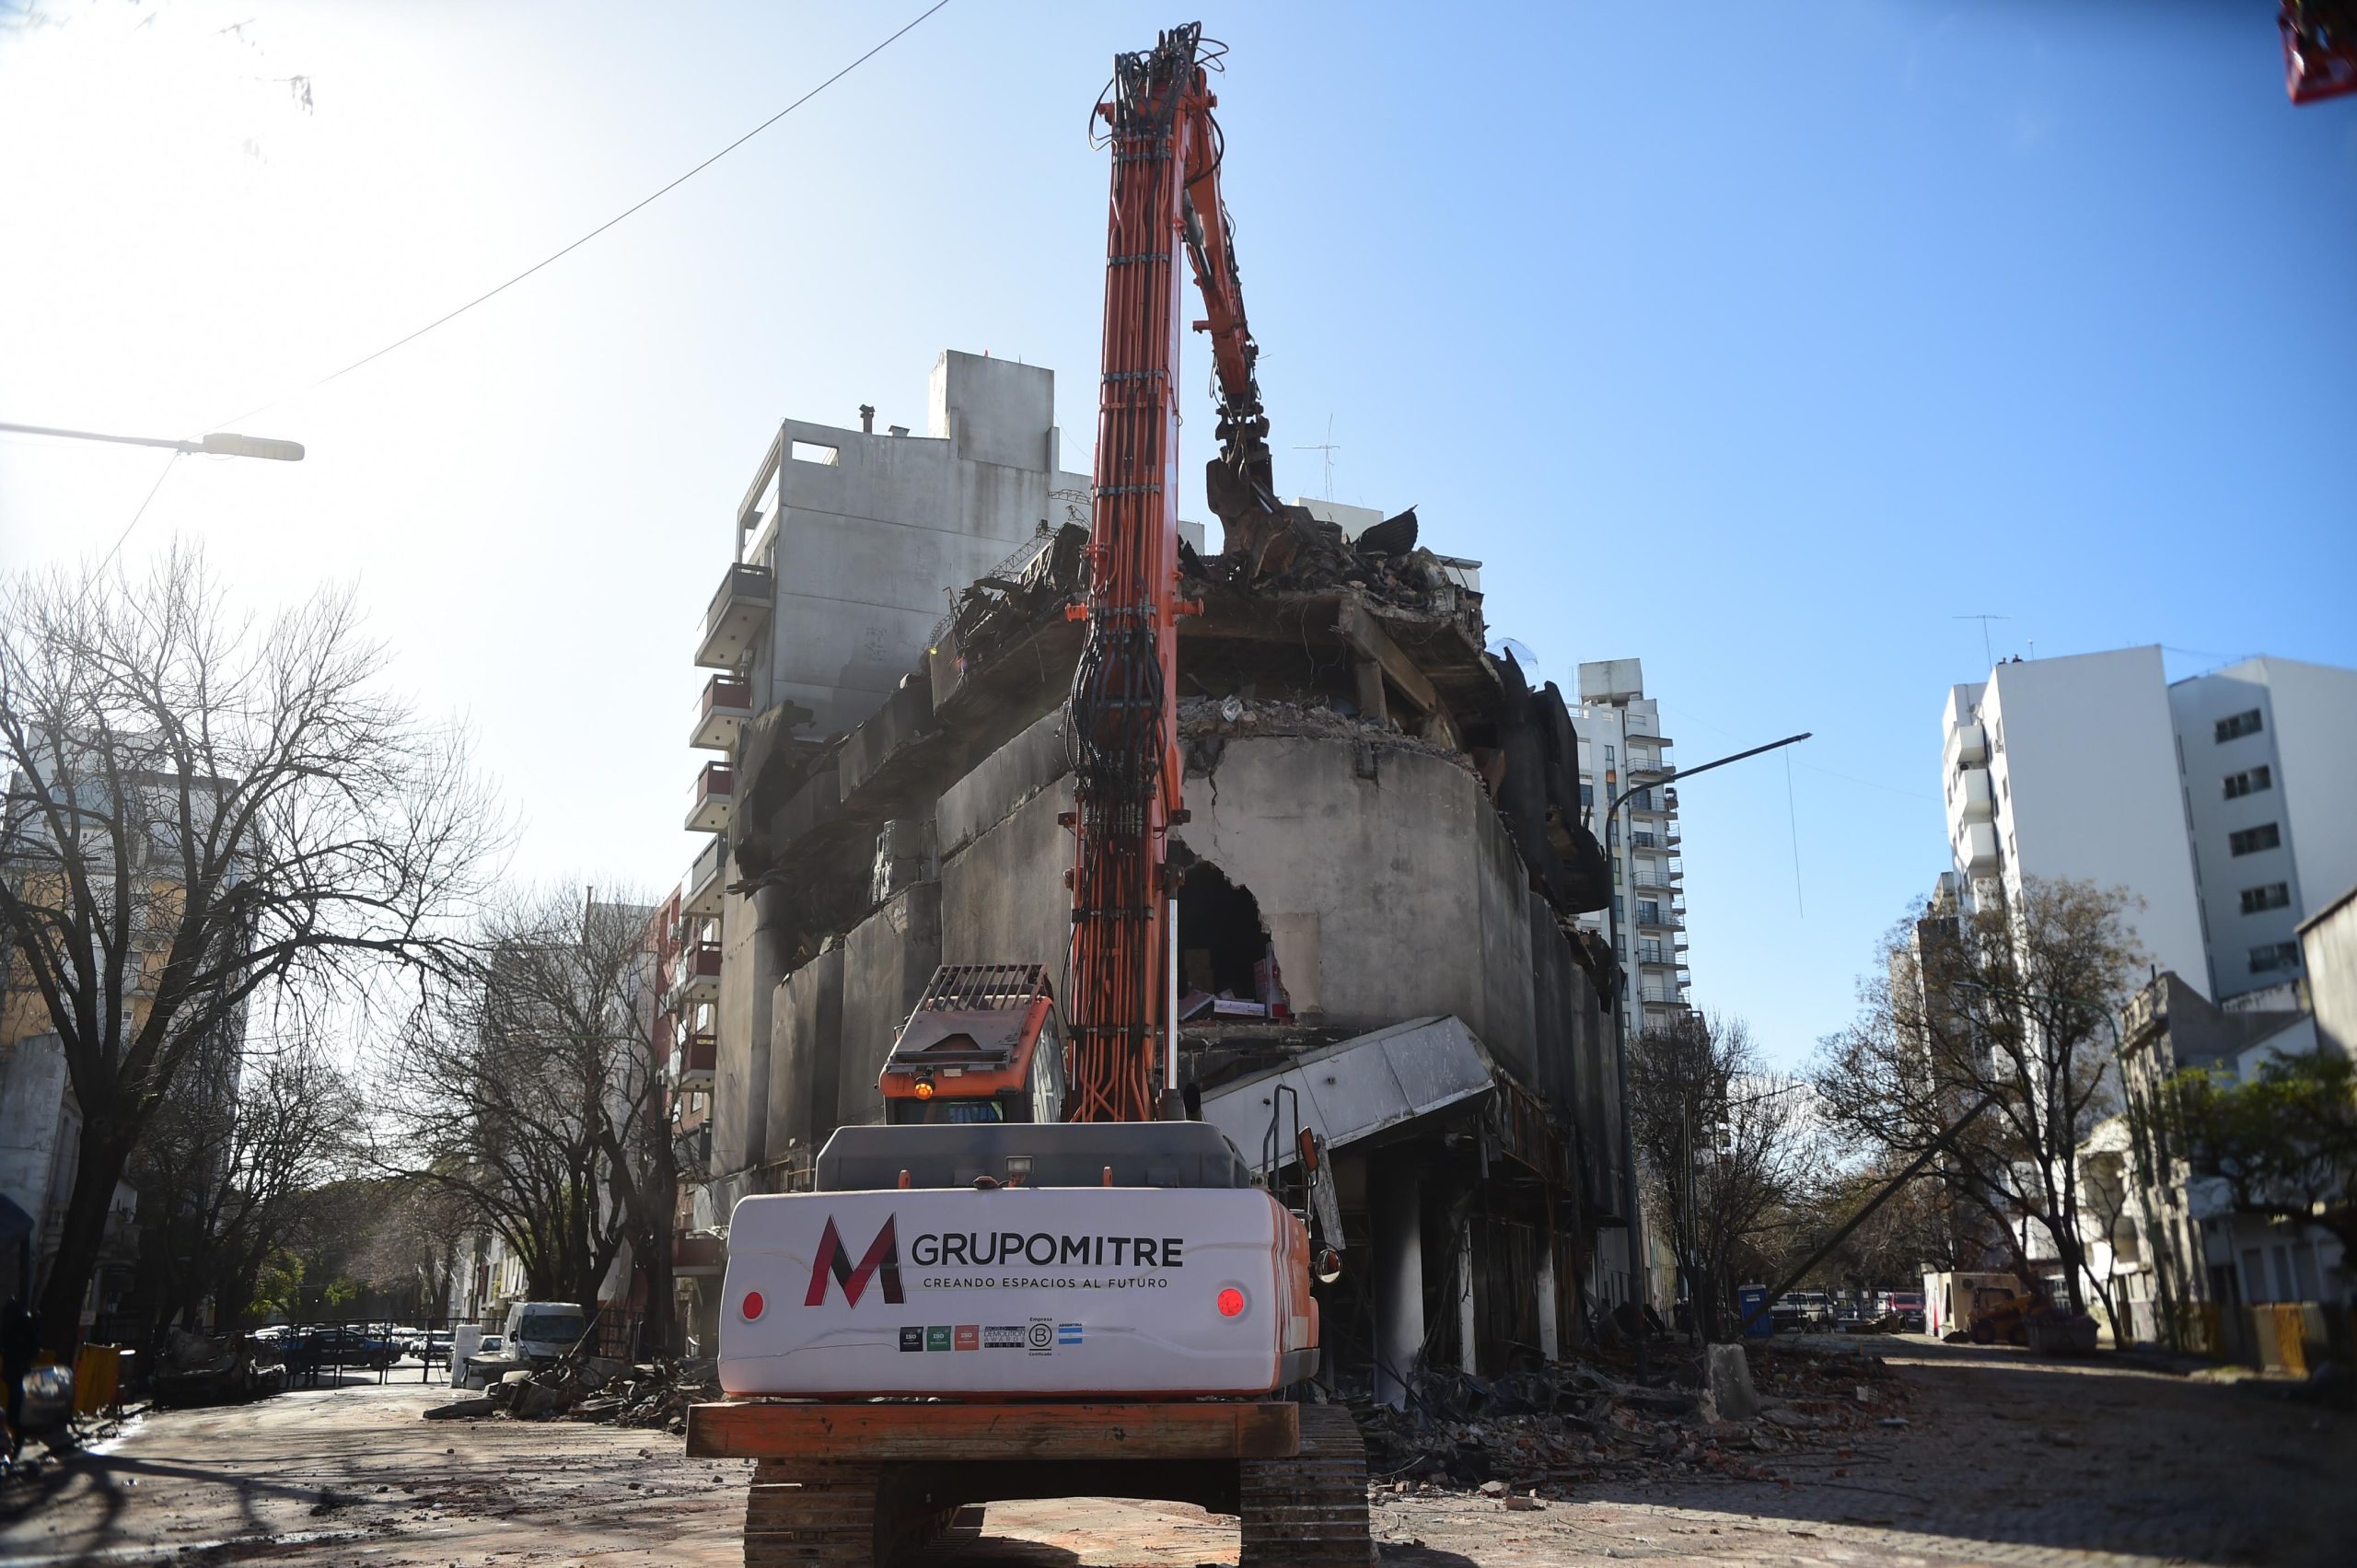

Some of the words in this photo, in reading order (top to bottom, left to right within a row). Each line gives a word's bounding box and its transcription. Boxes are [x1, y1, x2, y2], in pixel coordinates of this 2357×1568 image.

[804, 1212, 906, 1308] M
[911, 1232, 1184, 1267] GRUPOMITRE
[923, 1278, 995, 1288] CREANDO
[1002, 1278, 1075, 1288] ESPACIOS
[1083, 1279, 1101, 1289] AL
[1108, 1279, 1168, 1288] FUTURO
[1035, 1328, 1047, 1342] B
